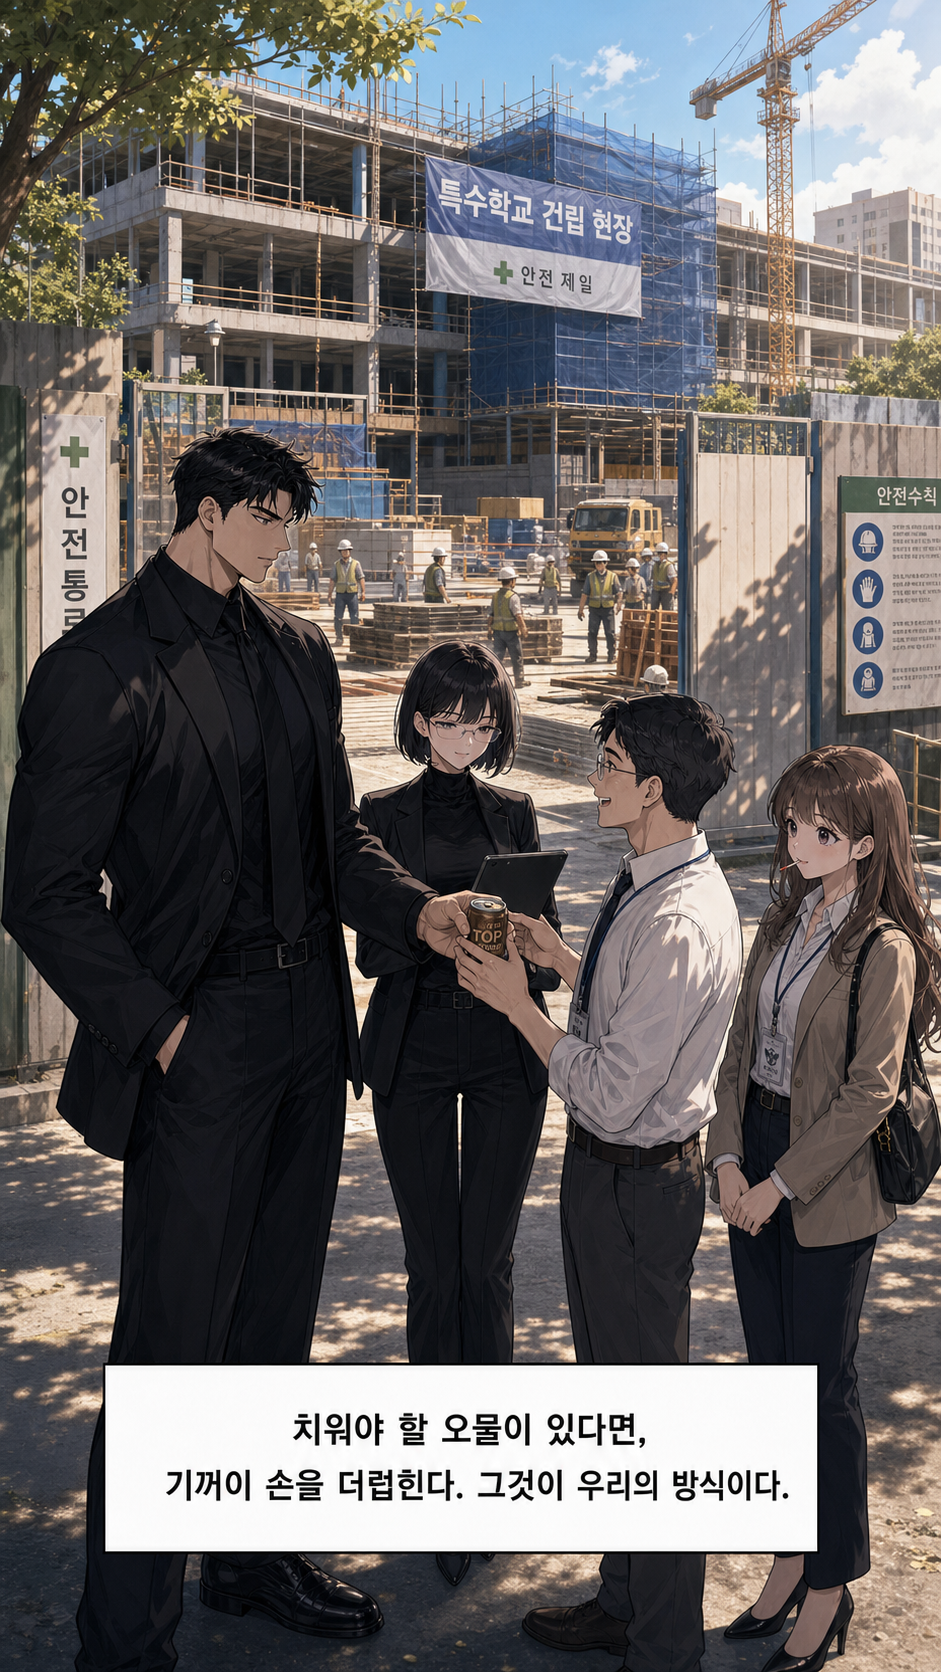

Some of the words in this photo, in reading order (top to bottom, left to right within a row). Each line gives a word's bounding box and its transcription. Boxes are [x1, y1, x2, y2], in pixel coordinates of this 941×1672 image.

[438, 178, 534, 225] 특수학교
[542, 200, 584, 237] 건립
[592, 208, 634, 245] 현장
[521, 265, 553, 289] 안전
[560, 272, 592, 294] 제일
[876, 486, 937, 507] 안전수칙
[472, 928, 503, 944] TOP
